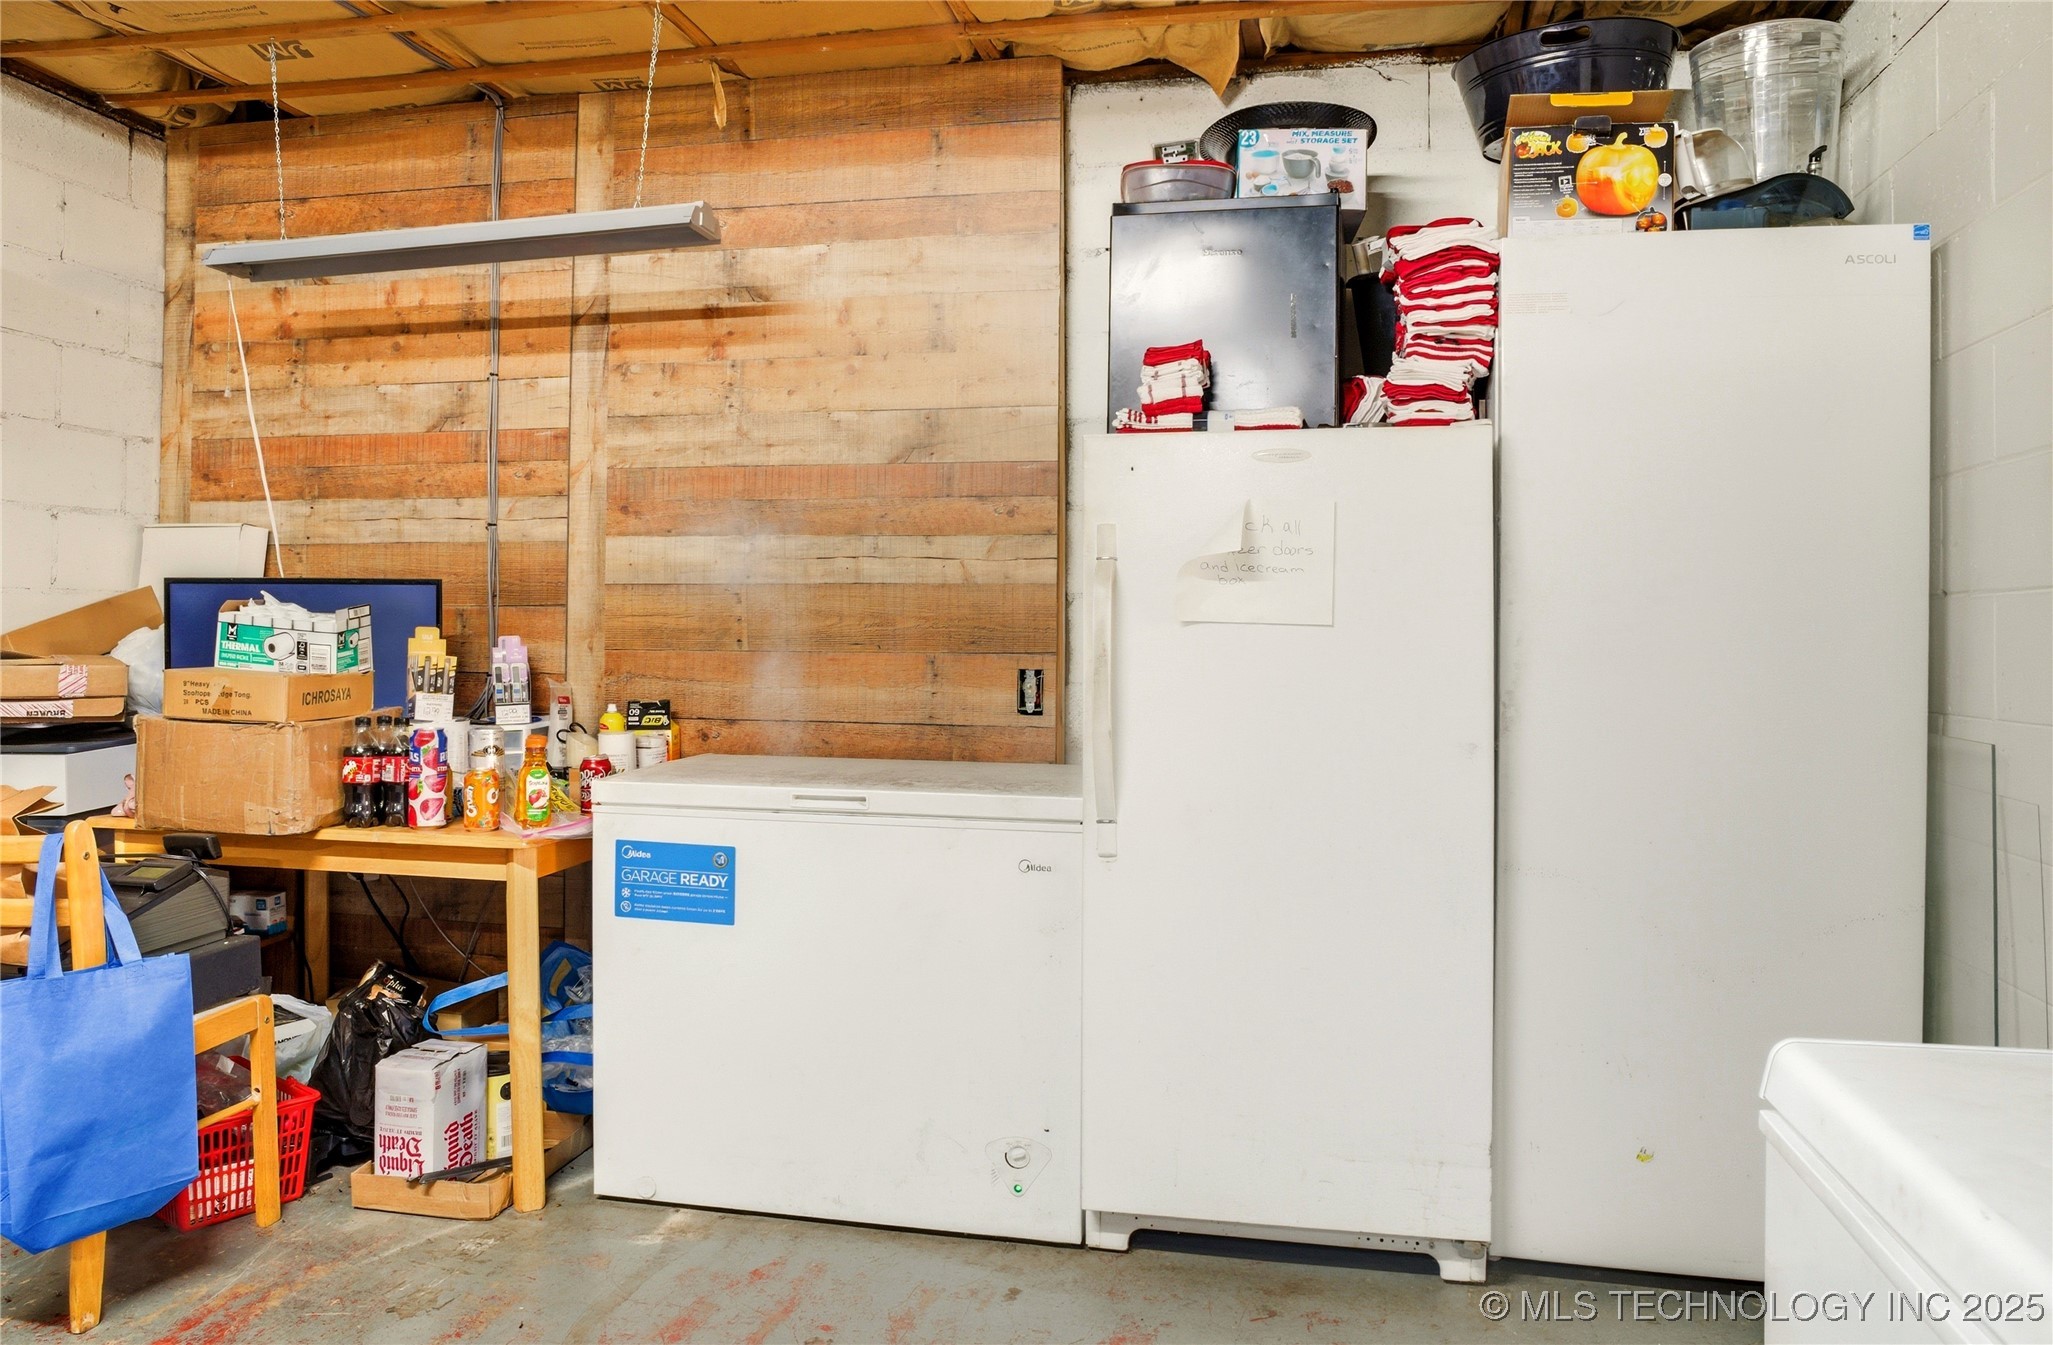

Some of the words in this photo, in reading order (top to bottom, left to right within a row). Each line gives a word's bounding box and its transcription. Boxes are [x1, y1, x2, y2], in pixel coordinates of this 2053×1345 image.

[1240, 130, 1257, 146] 23
[1311, 130, 1353, 138] MEASURE
[1300, 137, 1341, 145] STORAGE
[1844, 254, 1897, 265] ASCOLI
[1282, 519, 1302, 537] all
[1272, 539, 1314, 556] doors
[1199, 560, 1229, 574] and
[1217, 574, 1246, 586] box
[220, 640, 261, 653] THERMAL
[195, 698, 209, 706] PCS
[301, 687, 352, 706] ICHROSAYA
[202, 707, 221, 715] MADE
[628, 708, 640, 716] 60
[625, 847, 651, 858] Midea
[1021, 861, 1052, 873] Midea
[621, 868, 678, 885] GARAGE
[680, 873, 729, 888] READY
[379, 1134, 422, 1157] Death
[460, 1112, 475, 1168] Death
[444, 1121, 463, 1174] iquid
[379, 1152, 425, 1177] Liquid
